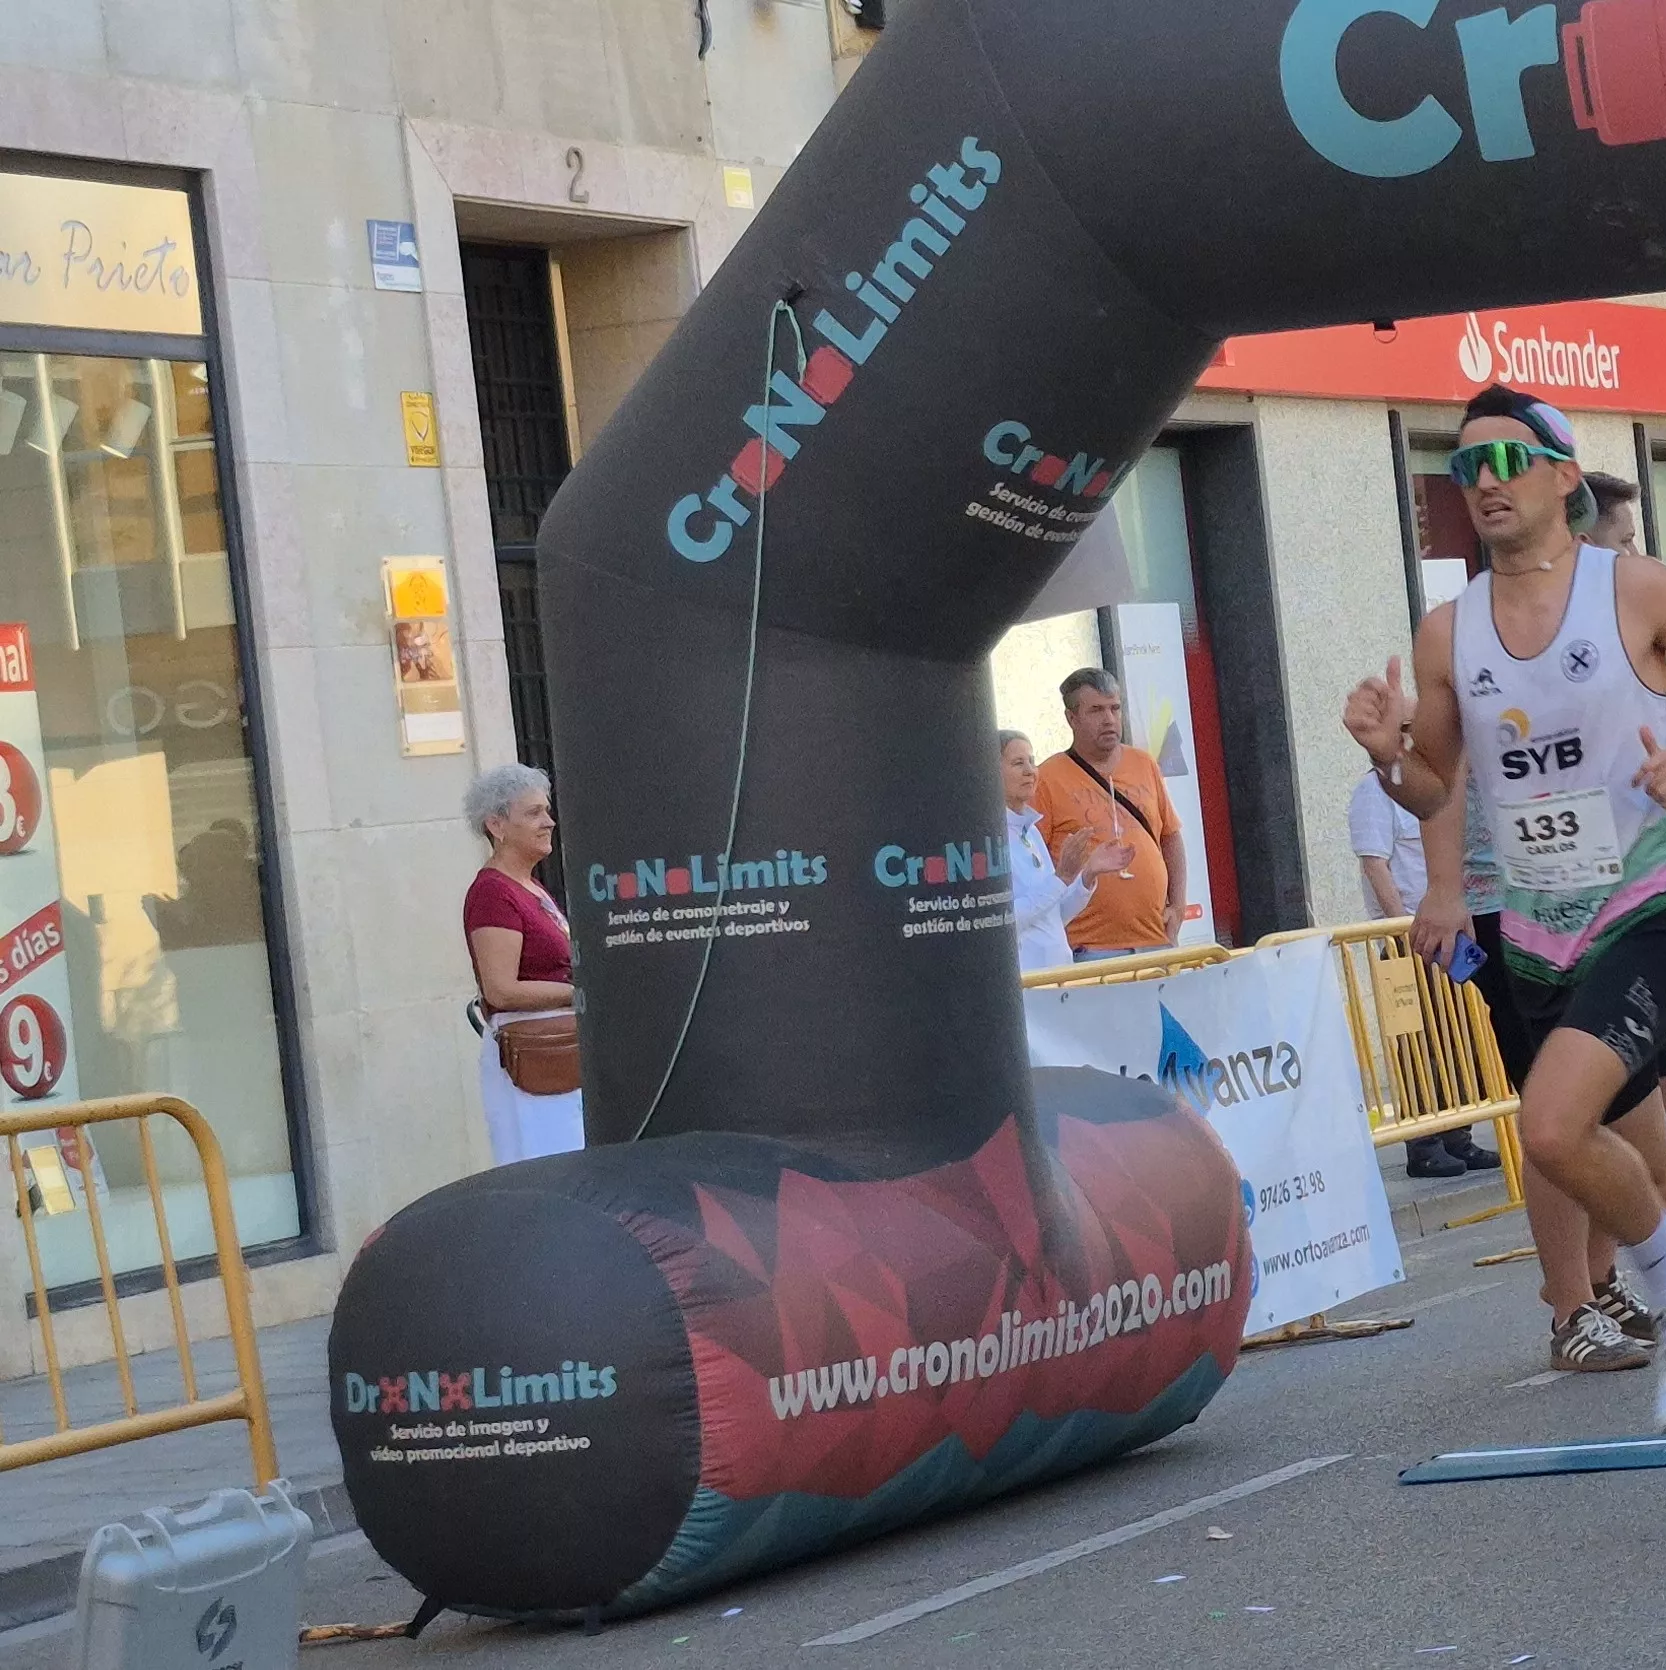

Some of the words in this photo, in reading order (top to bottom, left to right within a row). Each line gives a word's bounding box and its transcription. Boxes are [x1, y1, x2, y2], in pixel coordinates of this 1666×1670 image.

[566, 146, 590, 204] 2
[60, 219, 190, 298] Prieto
[1493, 320, 1620, 389] Santander
[1501, 736, 1584, 780] SYB
[1515, 810, 1581, 843] 133
[646, 926, 663, 943] de
[724, 917, 811, 937] deportivos
[652, 905, 669, 922] de
[11, 921, 61, 970] días
[768, 1257, 1232, 1422] www.cronolimits2020.com
[389, 1423, 443, 1441] Servicio
[446, 1420, 466, 1438] de
[537, 1417, 550, 1434] y
[406, 1439, 500, 1464] promocional
[503, 1433, 592, 1456] deportivo
